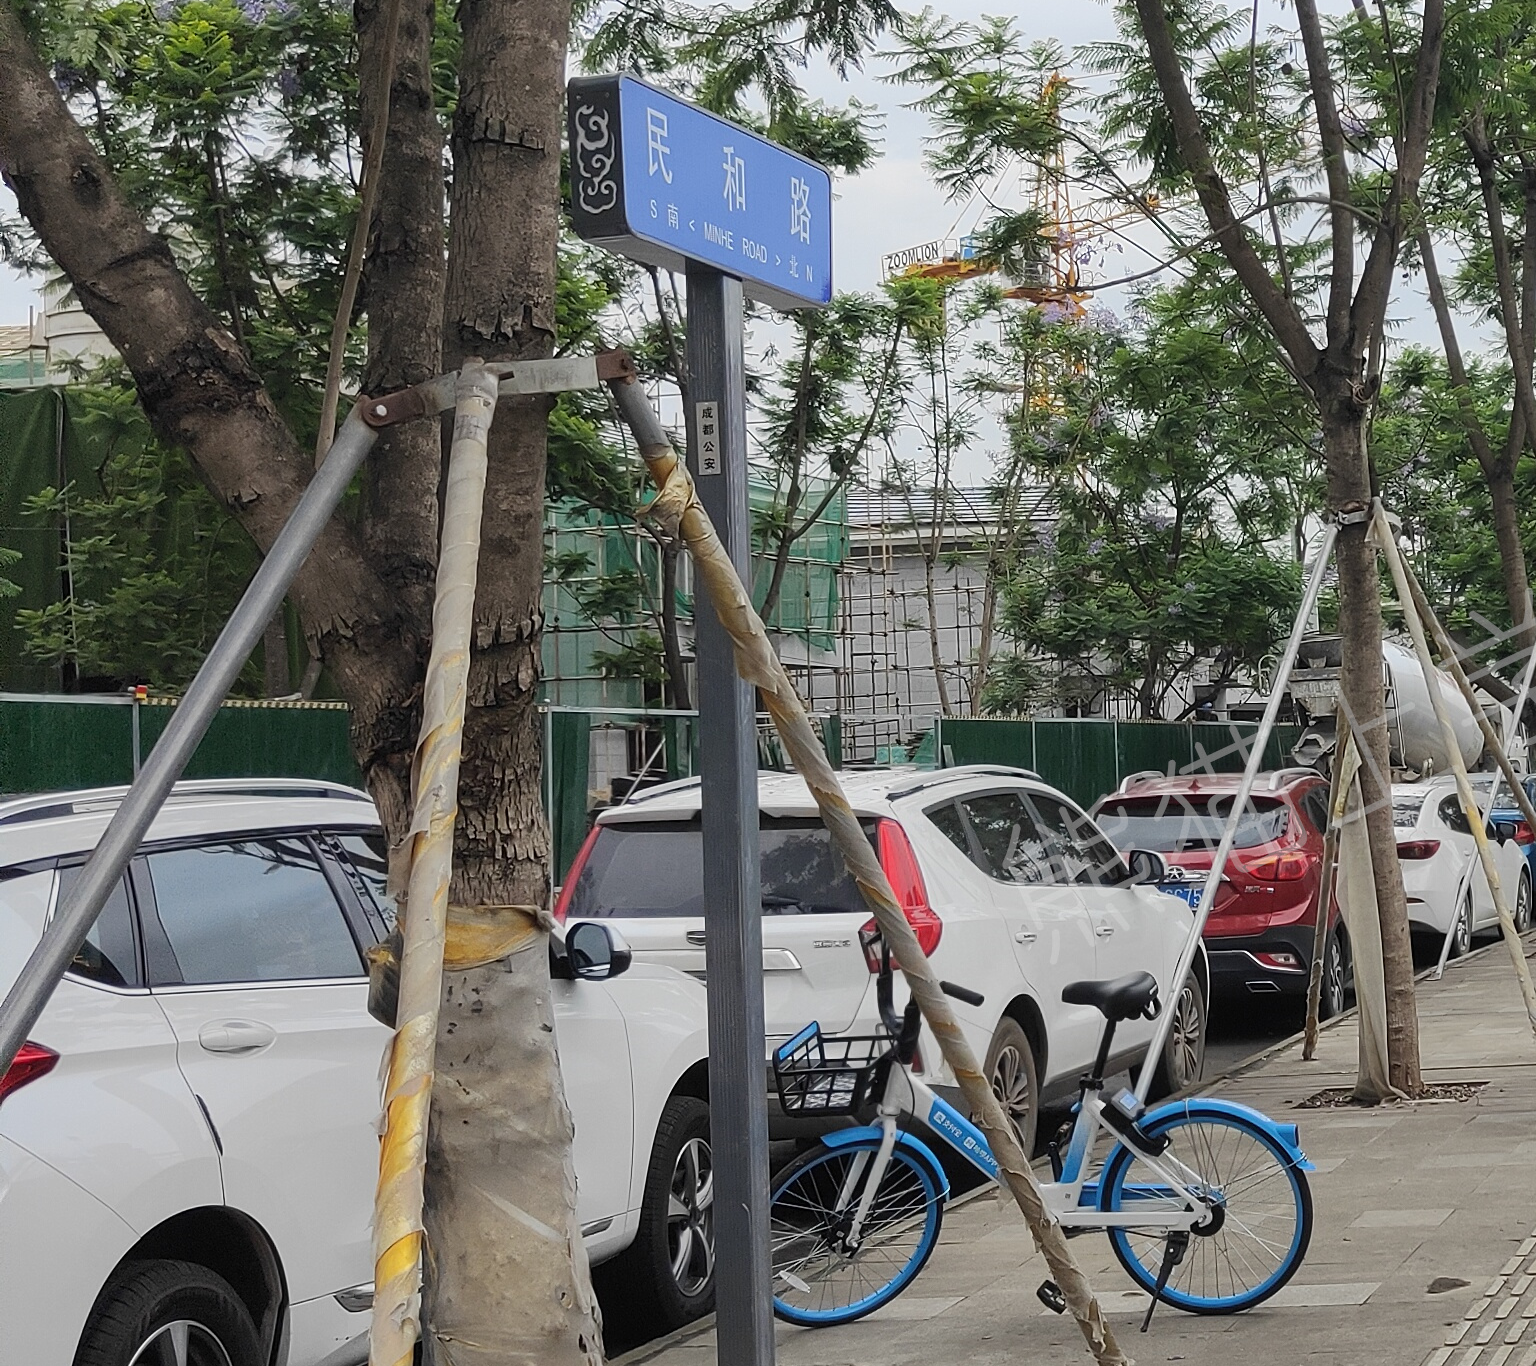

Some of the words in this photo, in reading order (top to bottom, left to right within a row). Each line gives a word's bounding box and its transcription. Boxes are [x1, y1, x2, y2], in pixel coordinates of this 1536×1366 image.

[646, 106, 811, 246] 民和路
[650, 199, 658, 219] S
[667, 203, 679, 230] 南
[704, 221, 734, 251] MINHE
[742, 237, 768, 264] ROAD
[789, 255, 799, 278] 北
[806, 264, 813, 283] N
[885, 241, 939, 270] ZOOMLION
[702, 407, 716, 470] 成都公安
